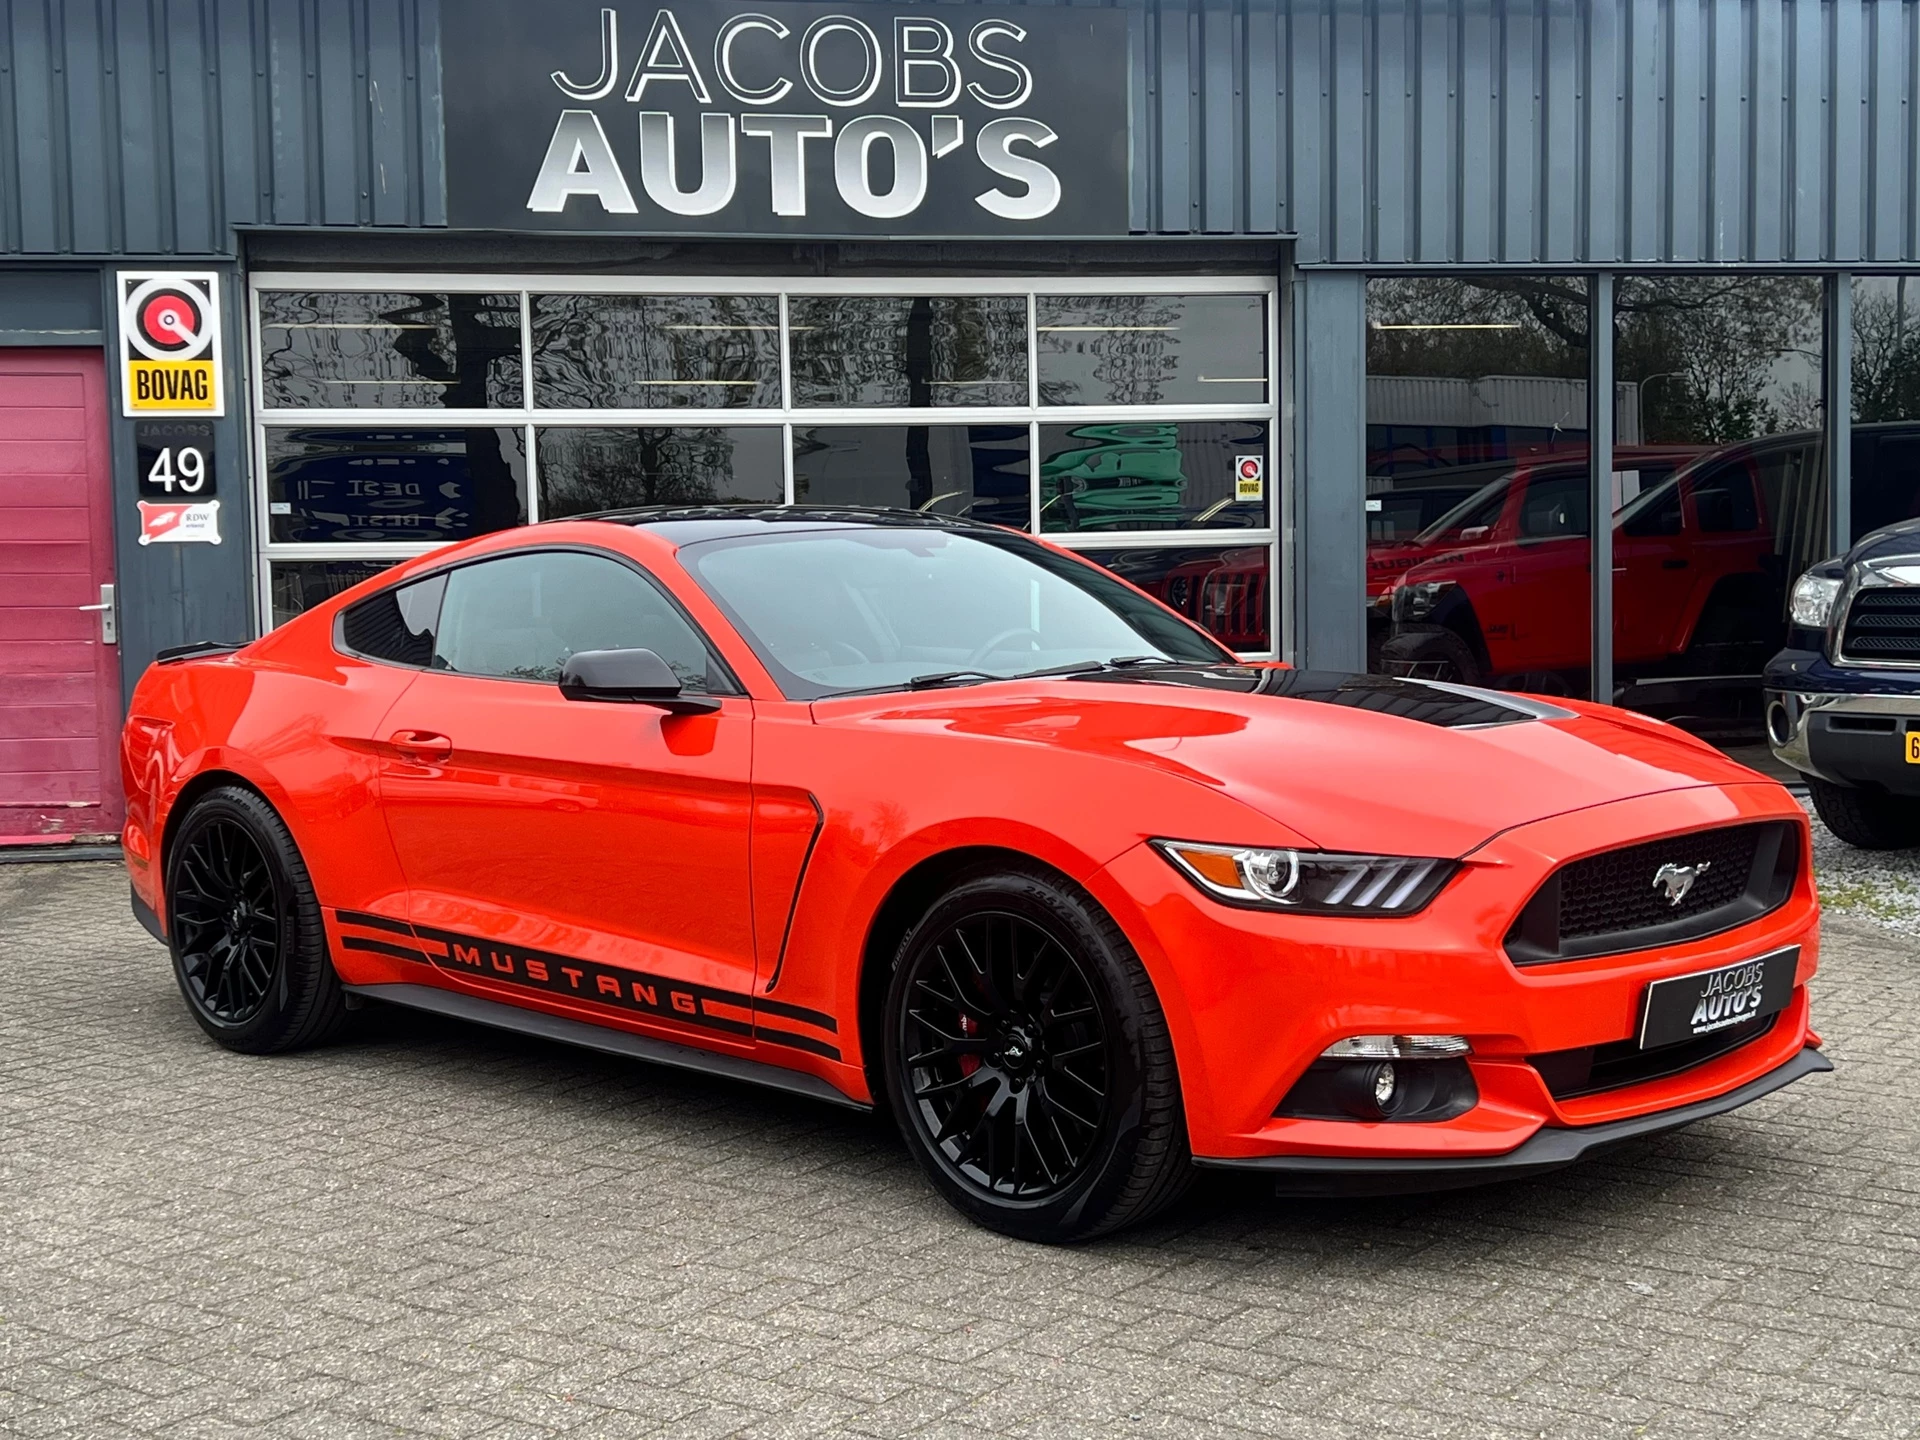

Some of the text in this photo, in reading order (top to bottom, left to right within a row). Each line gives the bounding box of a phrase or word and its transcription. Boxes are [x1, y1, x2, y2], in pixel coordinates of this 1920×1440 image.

[551, 8, 1033, 109] JACOBS
[527, 109, 1061, 220] AUTO'S
[136, 369, 208, 401] BOVAG
[139, 424, 210, 437] JACOBS
[148, 446, 205, 493] 49
[1239, 482, 1259, 493] BOVAG
[185, 513, 210, 521] RDW
[453, 943, 696, 1015] MUSTANG
[1700, 961, 1764, 998] JACOBS
[1690, 983, 1763, 1026] AUTO'S
